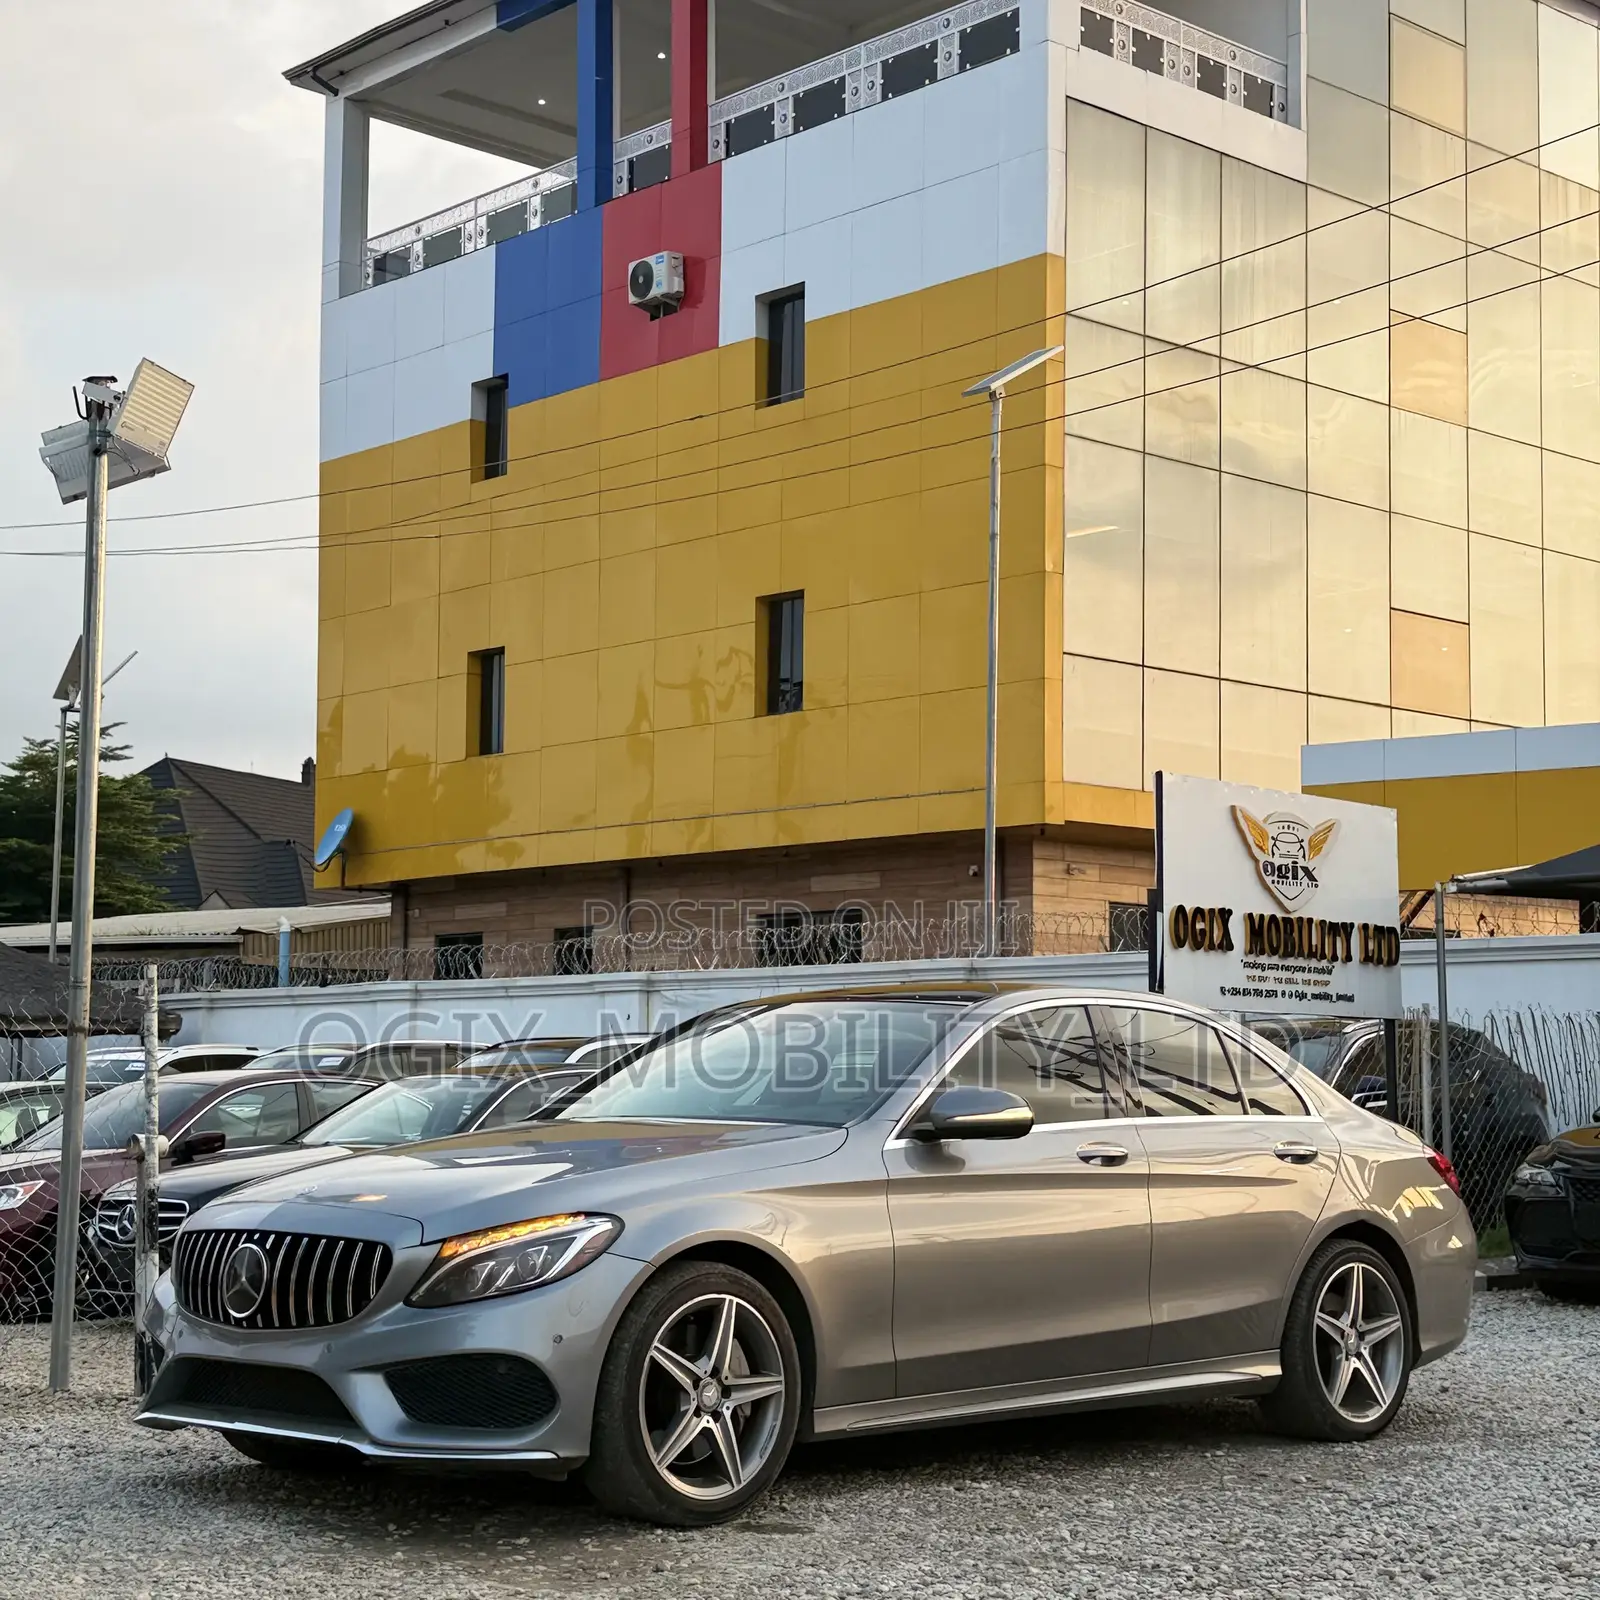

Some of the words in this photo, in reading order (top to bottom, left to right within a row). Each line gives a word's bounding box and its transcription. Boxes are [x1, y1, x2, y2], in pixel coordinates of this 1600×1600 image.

[1169, 904, 1235, 952] OGIX
[1243, 912, 1355, 964] MOBILITY
[1358, 922, 1400, 968] LTD
